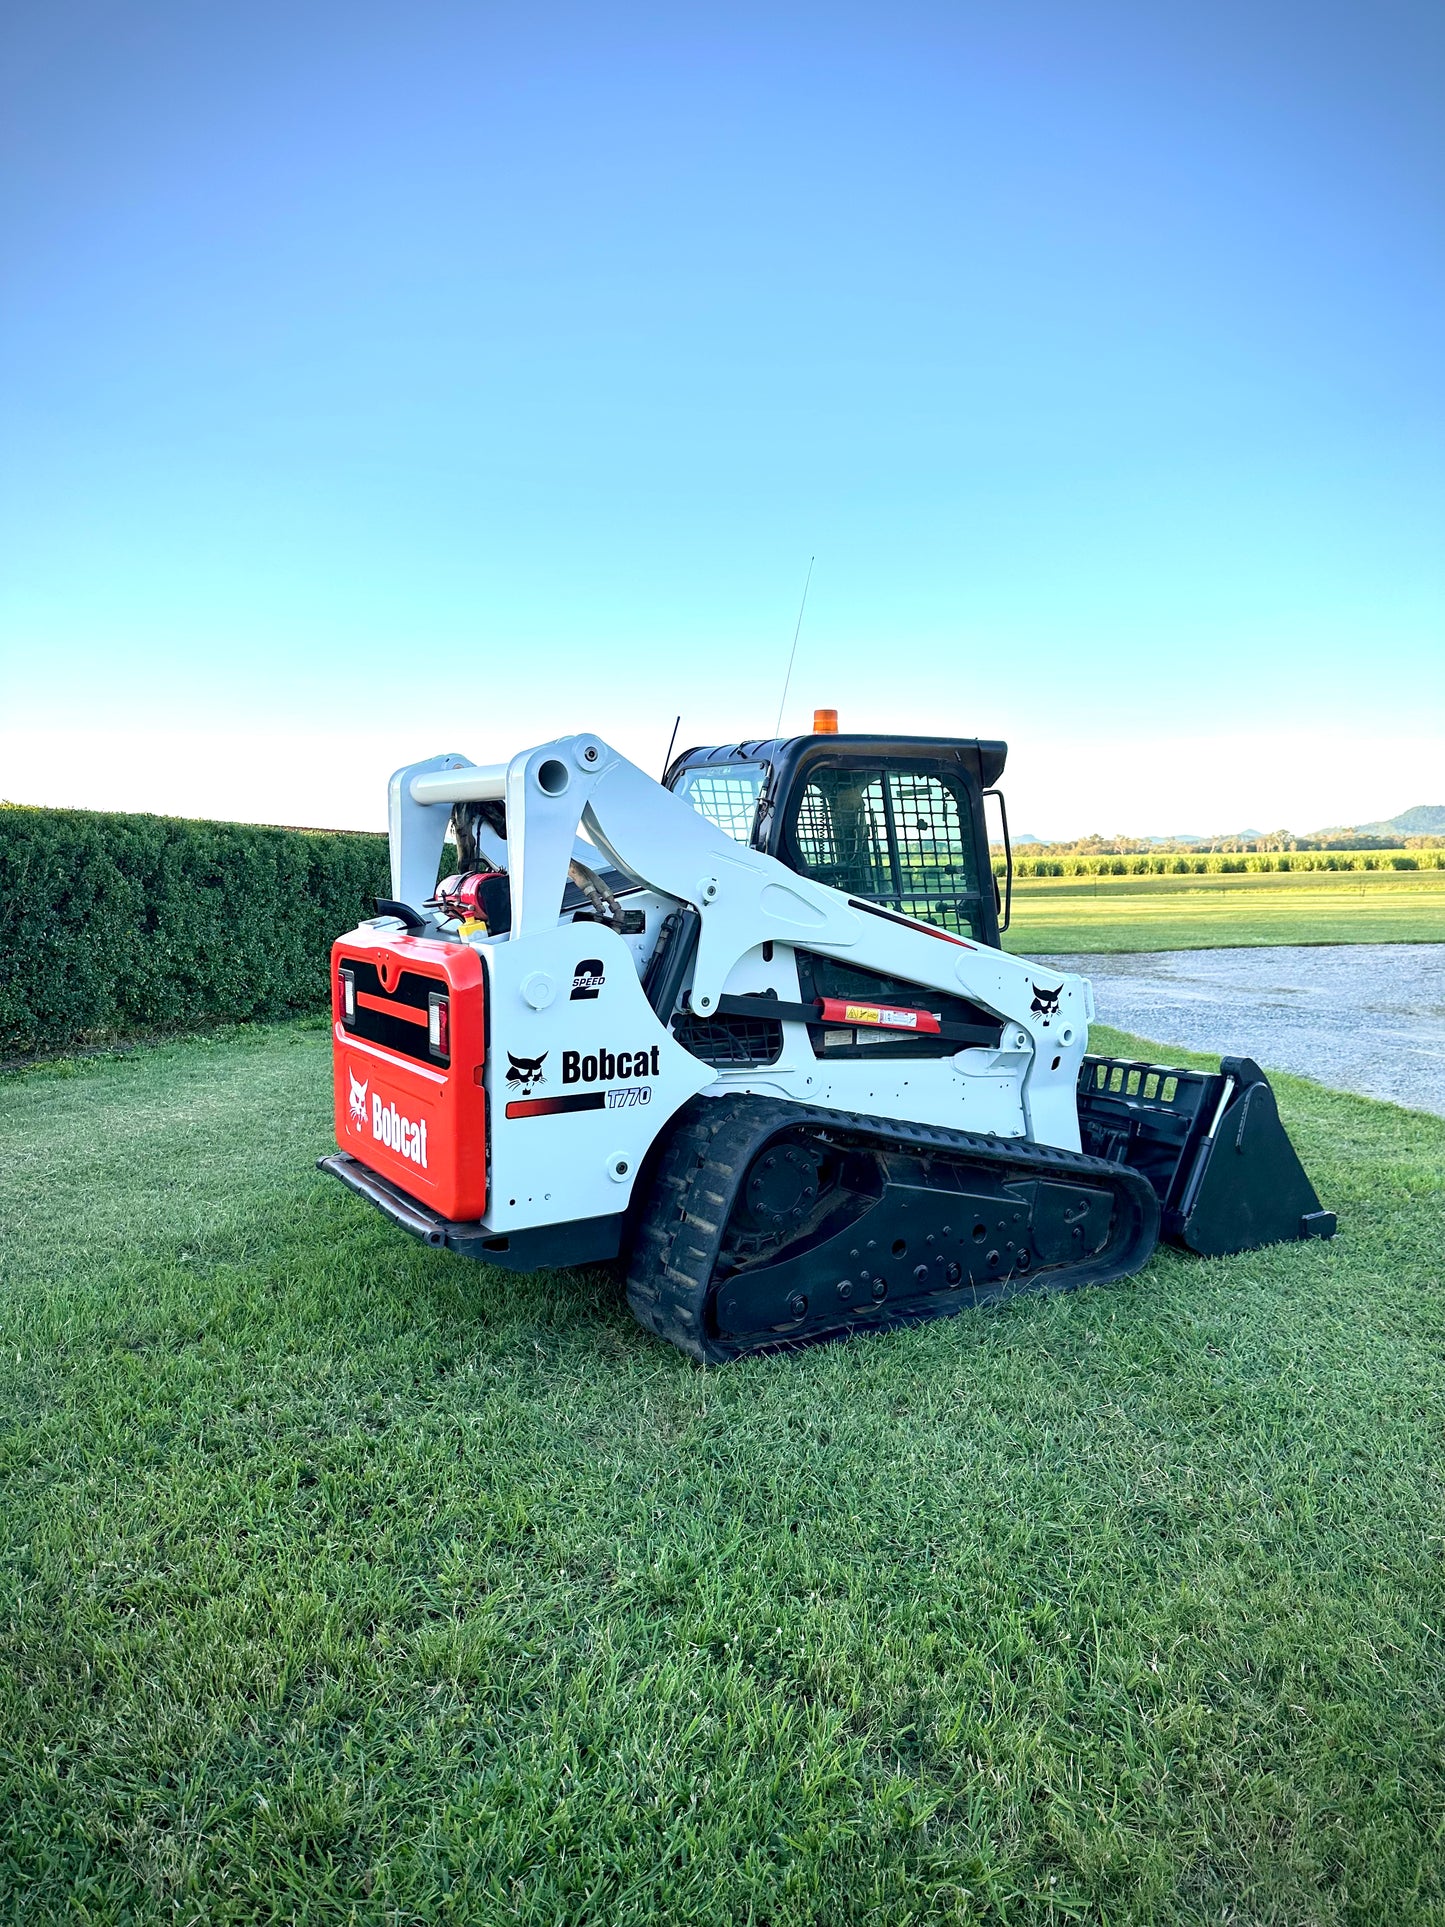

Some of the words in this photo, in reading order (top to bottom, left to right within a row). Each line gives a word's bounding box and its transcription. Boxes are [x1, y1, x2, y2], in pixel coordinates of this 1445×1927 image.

[570, 958, 604, 1001] 2
[572, 976, 606, 987] SPEED
[562, 1045, 660, 1084] Bobcat
[607, 1086, 652, 1108] T770
[371, 1093, 428, 1169] Bobcat
